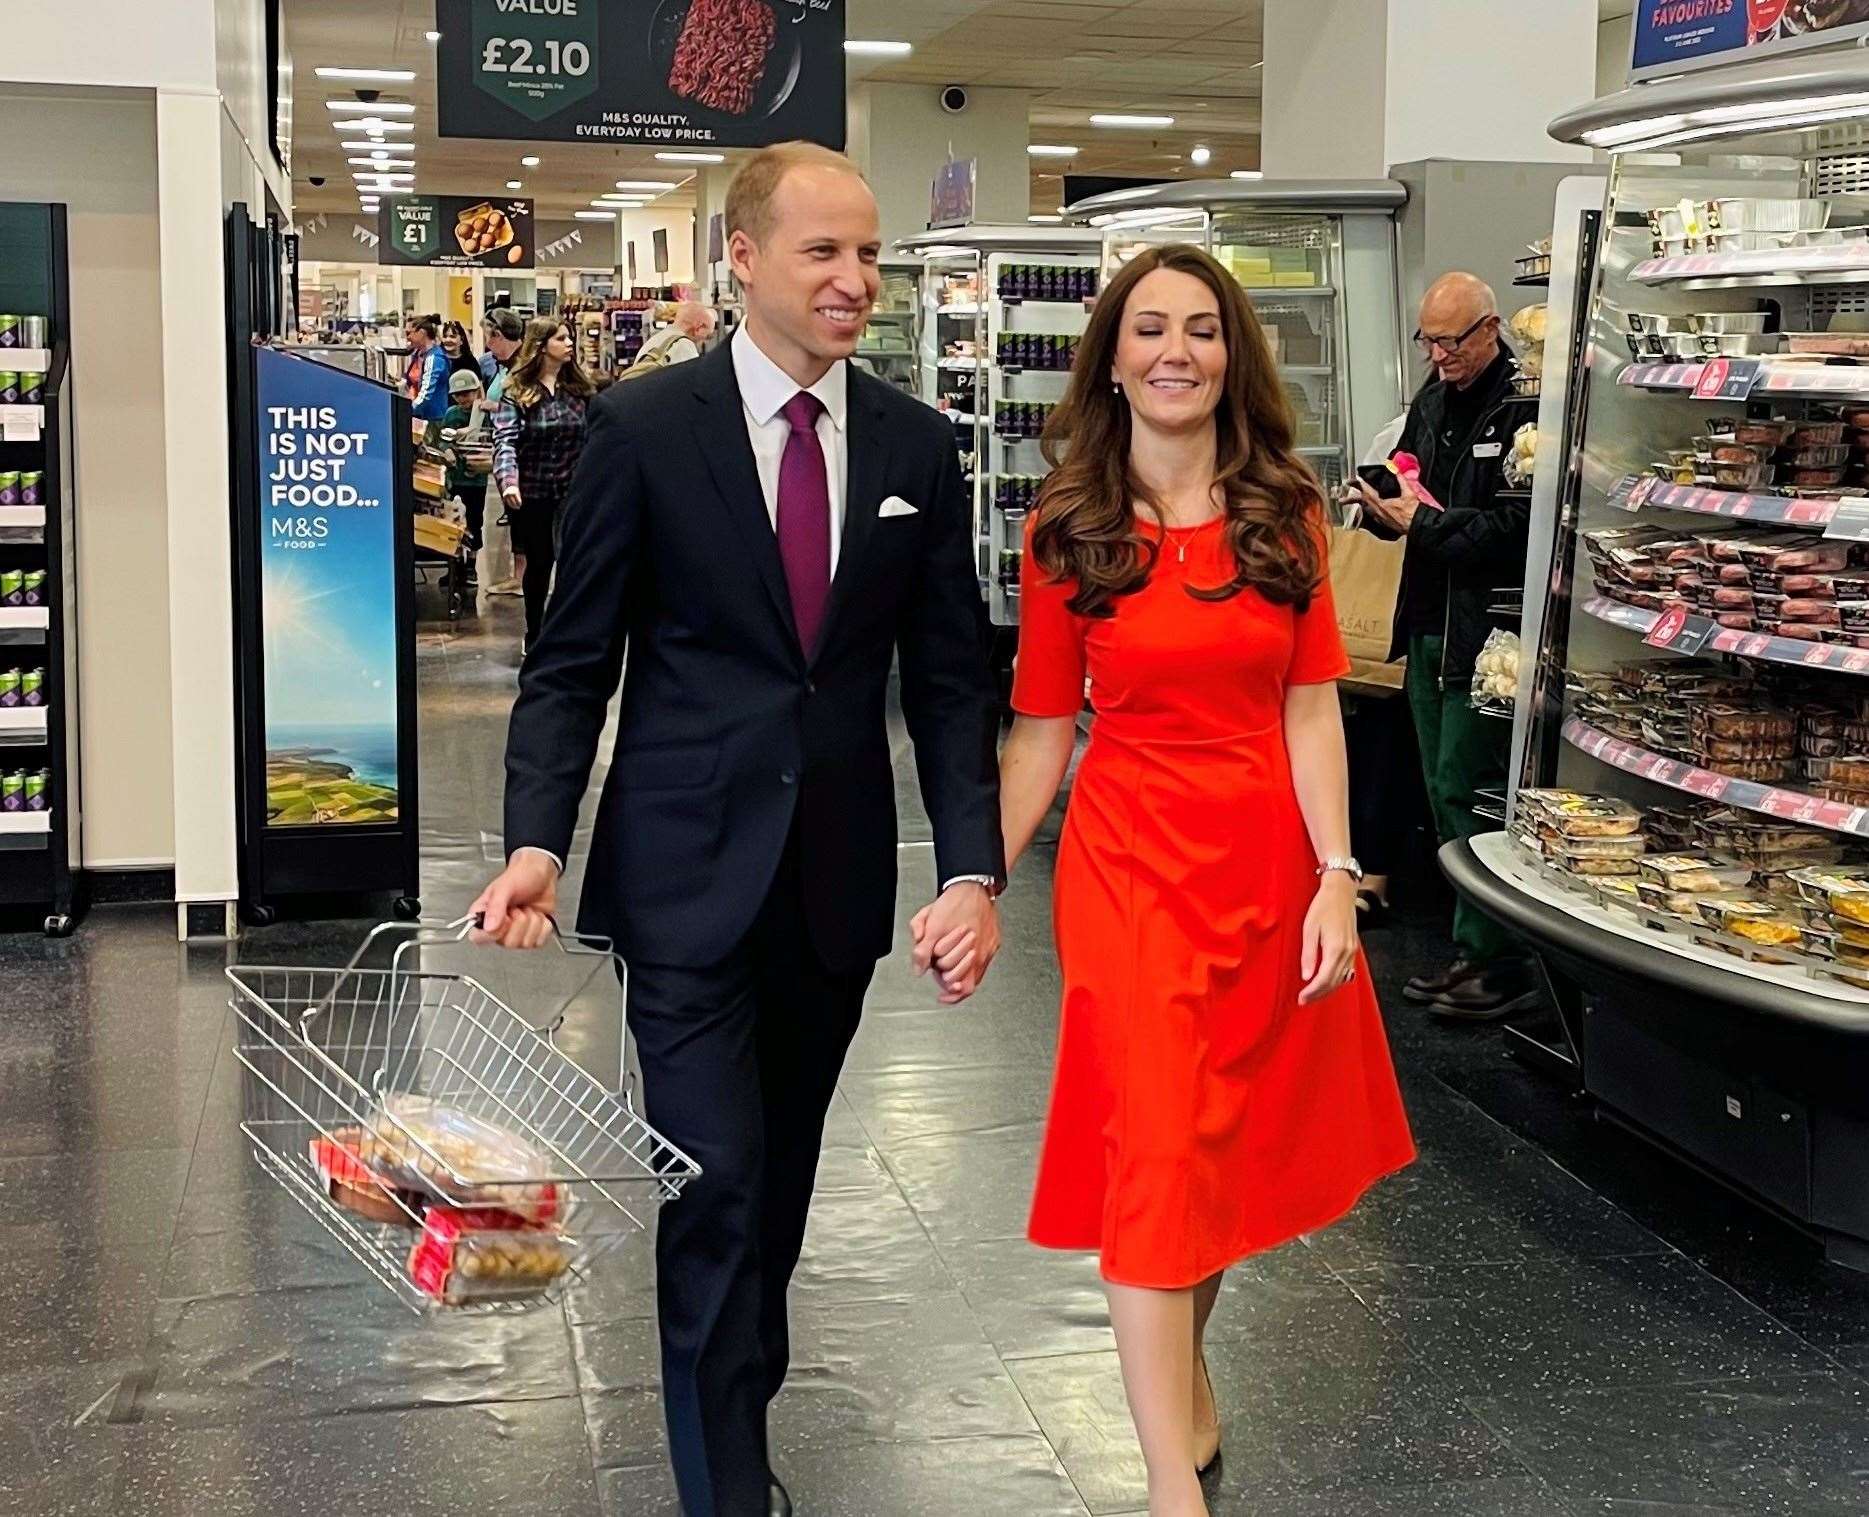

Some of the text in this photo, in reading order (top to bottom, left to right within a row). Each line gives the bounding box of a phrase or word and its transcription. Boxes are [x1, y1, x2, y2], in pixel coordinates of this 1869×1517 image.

[496, 0, 577, 15] VALUE
[1652, 0, 1733, 29] FAVOURITES
[482, 38, 590, 76] £2.10
[602, 112, 690, 126] M&S QUALITY.
[576, 125, 716, 140] EVERYDAY LOW PRICE.
[398, 211, 431, 221] VALUE
[403, 224, 426, 243] £1
[267, 407, 337, 430] THIS
[270, 433, 369, 455] IS NOT
[269, 459, 346, 481] JUST
[271, 485, 379, 507] FOOD...
[272, 517, 329, 538] M&S
[284, 541, 316, 549] FOOD
